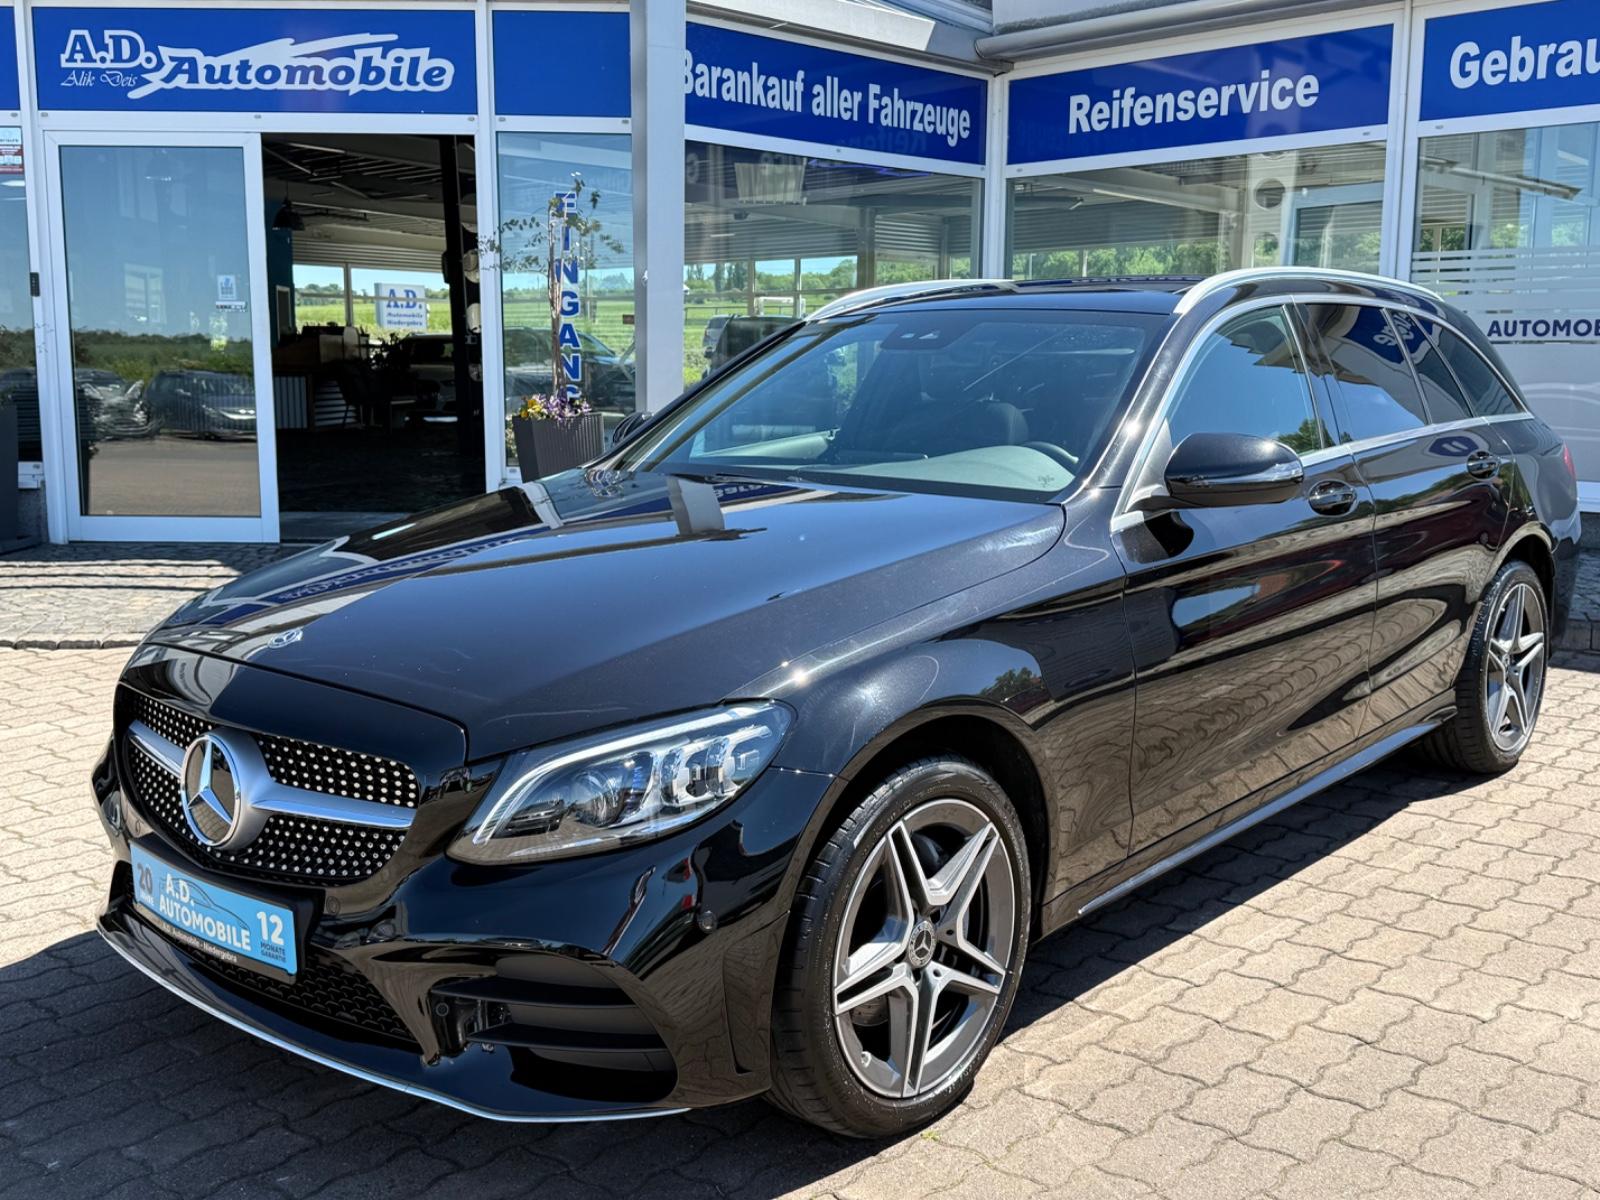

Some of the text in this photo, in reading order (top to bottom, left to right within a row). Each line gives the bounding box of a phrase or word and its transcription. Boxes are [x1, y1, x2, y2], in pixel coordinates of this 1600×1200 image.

[60, 29, 456, 96] A.D. Automobile
[60, 70, 138, 87] Alik Deis
[812, 75, 863, 121] aller
[868, 83, 971, 147] Fahrzeuge
[1068, 70, 1320, 135] Reifenservice
[386, 288, 422, 309] A.D.
[137, 862, 285, 945] 20 12
[166, 873, 195, 907] A.D.
[159, 894, 251, 951] AUTOMOBILE
